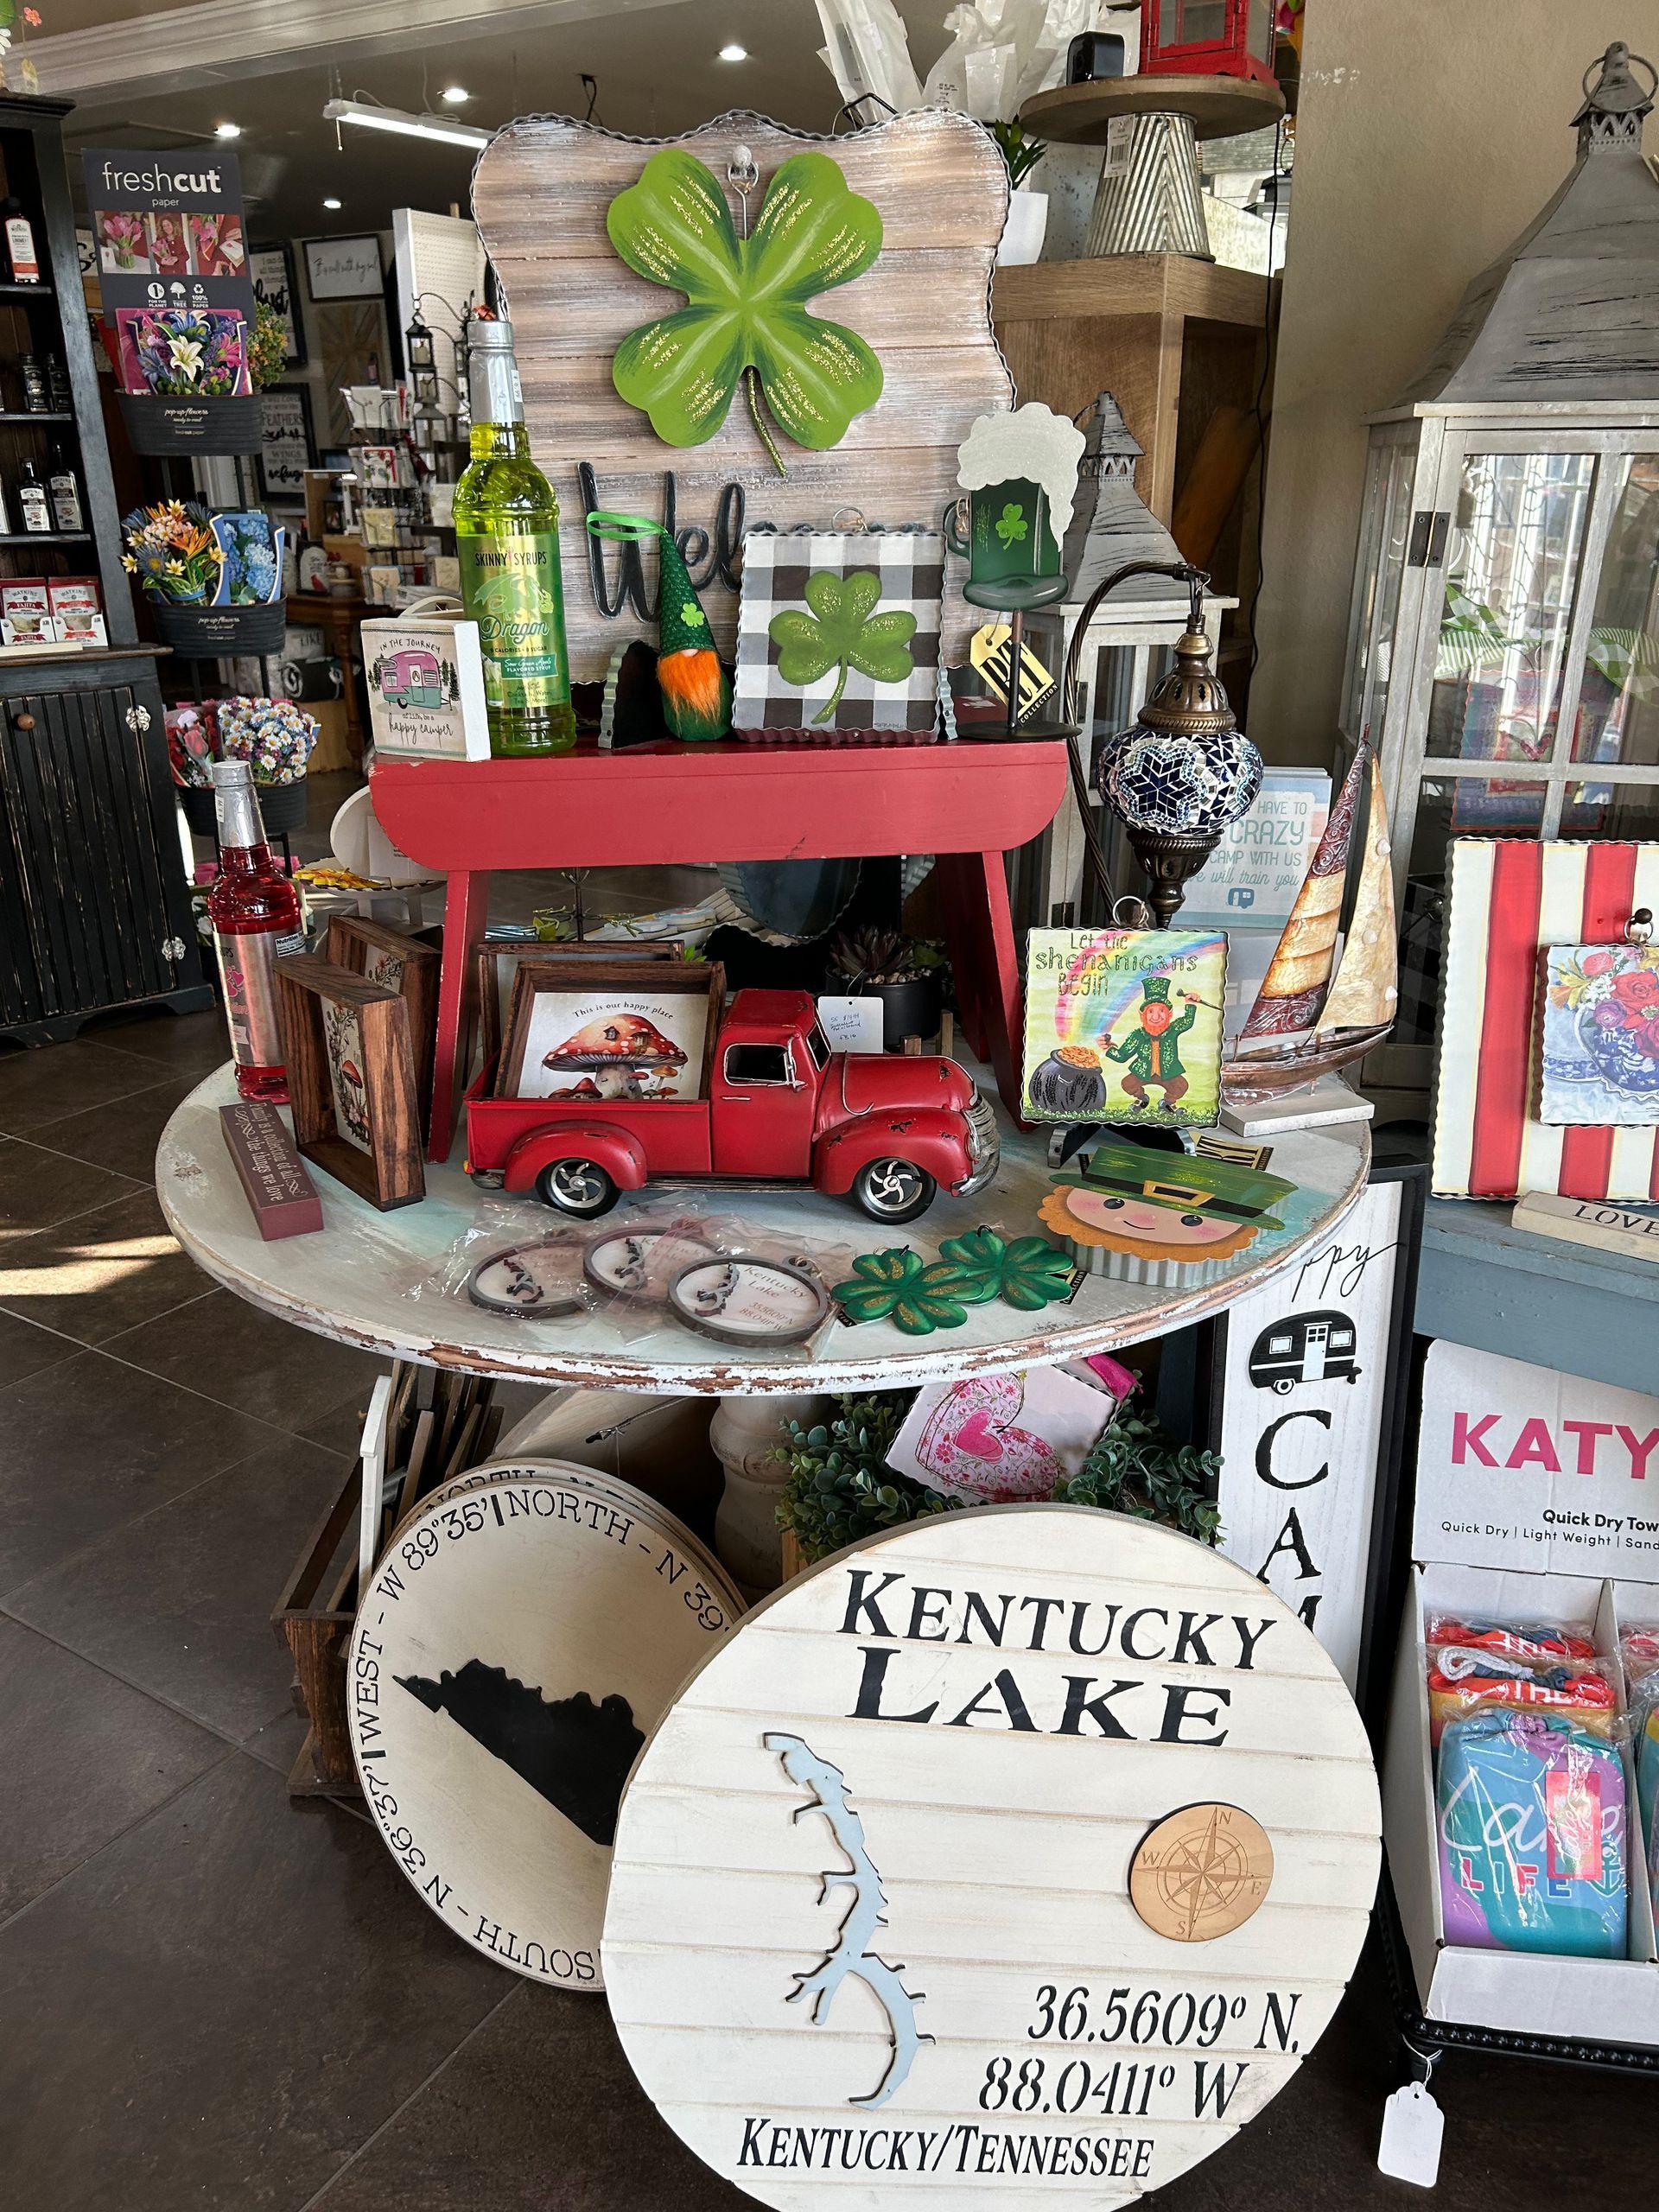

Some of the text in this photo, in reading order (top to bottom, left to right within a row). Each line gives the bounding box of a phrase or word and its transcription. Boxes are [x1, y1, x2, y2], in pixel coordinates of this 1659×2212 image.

[102, 162, 222, 194] freshcut
[151, 199, 180, 208] paper
[474, 551, 547, 567] SKINNY SYRUPS
[480, 614, 550, 646] Dragon
[379, 639, 441, 654] IN THE JOURNEY
[1020, 683, 1058, 724] COLLECTION
[389, 712, 454, 748] happy camper
[1257, 800, 1307, 816] HAVE TO
[1230, 819, 1305, 846] CRAZY
[1210, 849, 1301, 867] CAMP WITH US
[1211, 867, 1234, 884] will
[1238, 870, 1270, 885] train
[1274, 873, 1300, 892] you
[276, 933, 298, 945] Nutrition
[1070, 931, 1128, 950] Let the
[1035, 946, 1198, 976] shenanigans
[573, 1007, 594, 1018] This
[623, 1001, 651, 1013] happy
[651, 1007, 674, 1020] place
[249, 1103, 272, 1122] Family
[264, 1134, 289, 1162] collection
[246, 1137, 285, 1202] the things we love
[744, 1267, 809, 1298] Kentucky
[748, 1281, 780, 1299] Lake
[1451, 1411, 1659, 1480] KATY
[1440, 1520, 1481, 1535] Quick
[1484, 1523, 1509, 1539] Dry
[1522, 1527, 1558, 1544] Light
[1562, 1532, 1611, 1548] Weight
[1541, 1510, 1591, 1528] Quick
[1594, 1513, 1624, 1533] Dry
[505, 1489, 636, 1547] NORTH
[655, 1548, 689, 1585] N
[836, 1568, 1278, 1670] KENTUCKY
[356, 1628, 385, 1748] WEST
[377, 1565, 407, 1602] W
[844, 1645, 1231, 1748] LAKE
[1219, 1811, 1232, 1825] N
[1440, 1765, 1624, 1853] Lae
[1141, 1851, 1160, 1866] W
[423, 1874, 454, 1910] N
[1250, 1881, 1262, 1896] E
[1461, 1856, 1573, 1899] LIFE
[1176, 1920, 1186, 1936] S
[473, 1914, 597, 1980] SOUTH
[1192, 2061, 1251, 2120] W
[737, 2117, 1155, 2178] KENTUCKY/TENNESSEE
